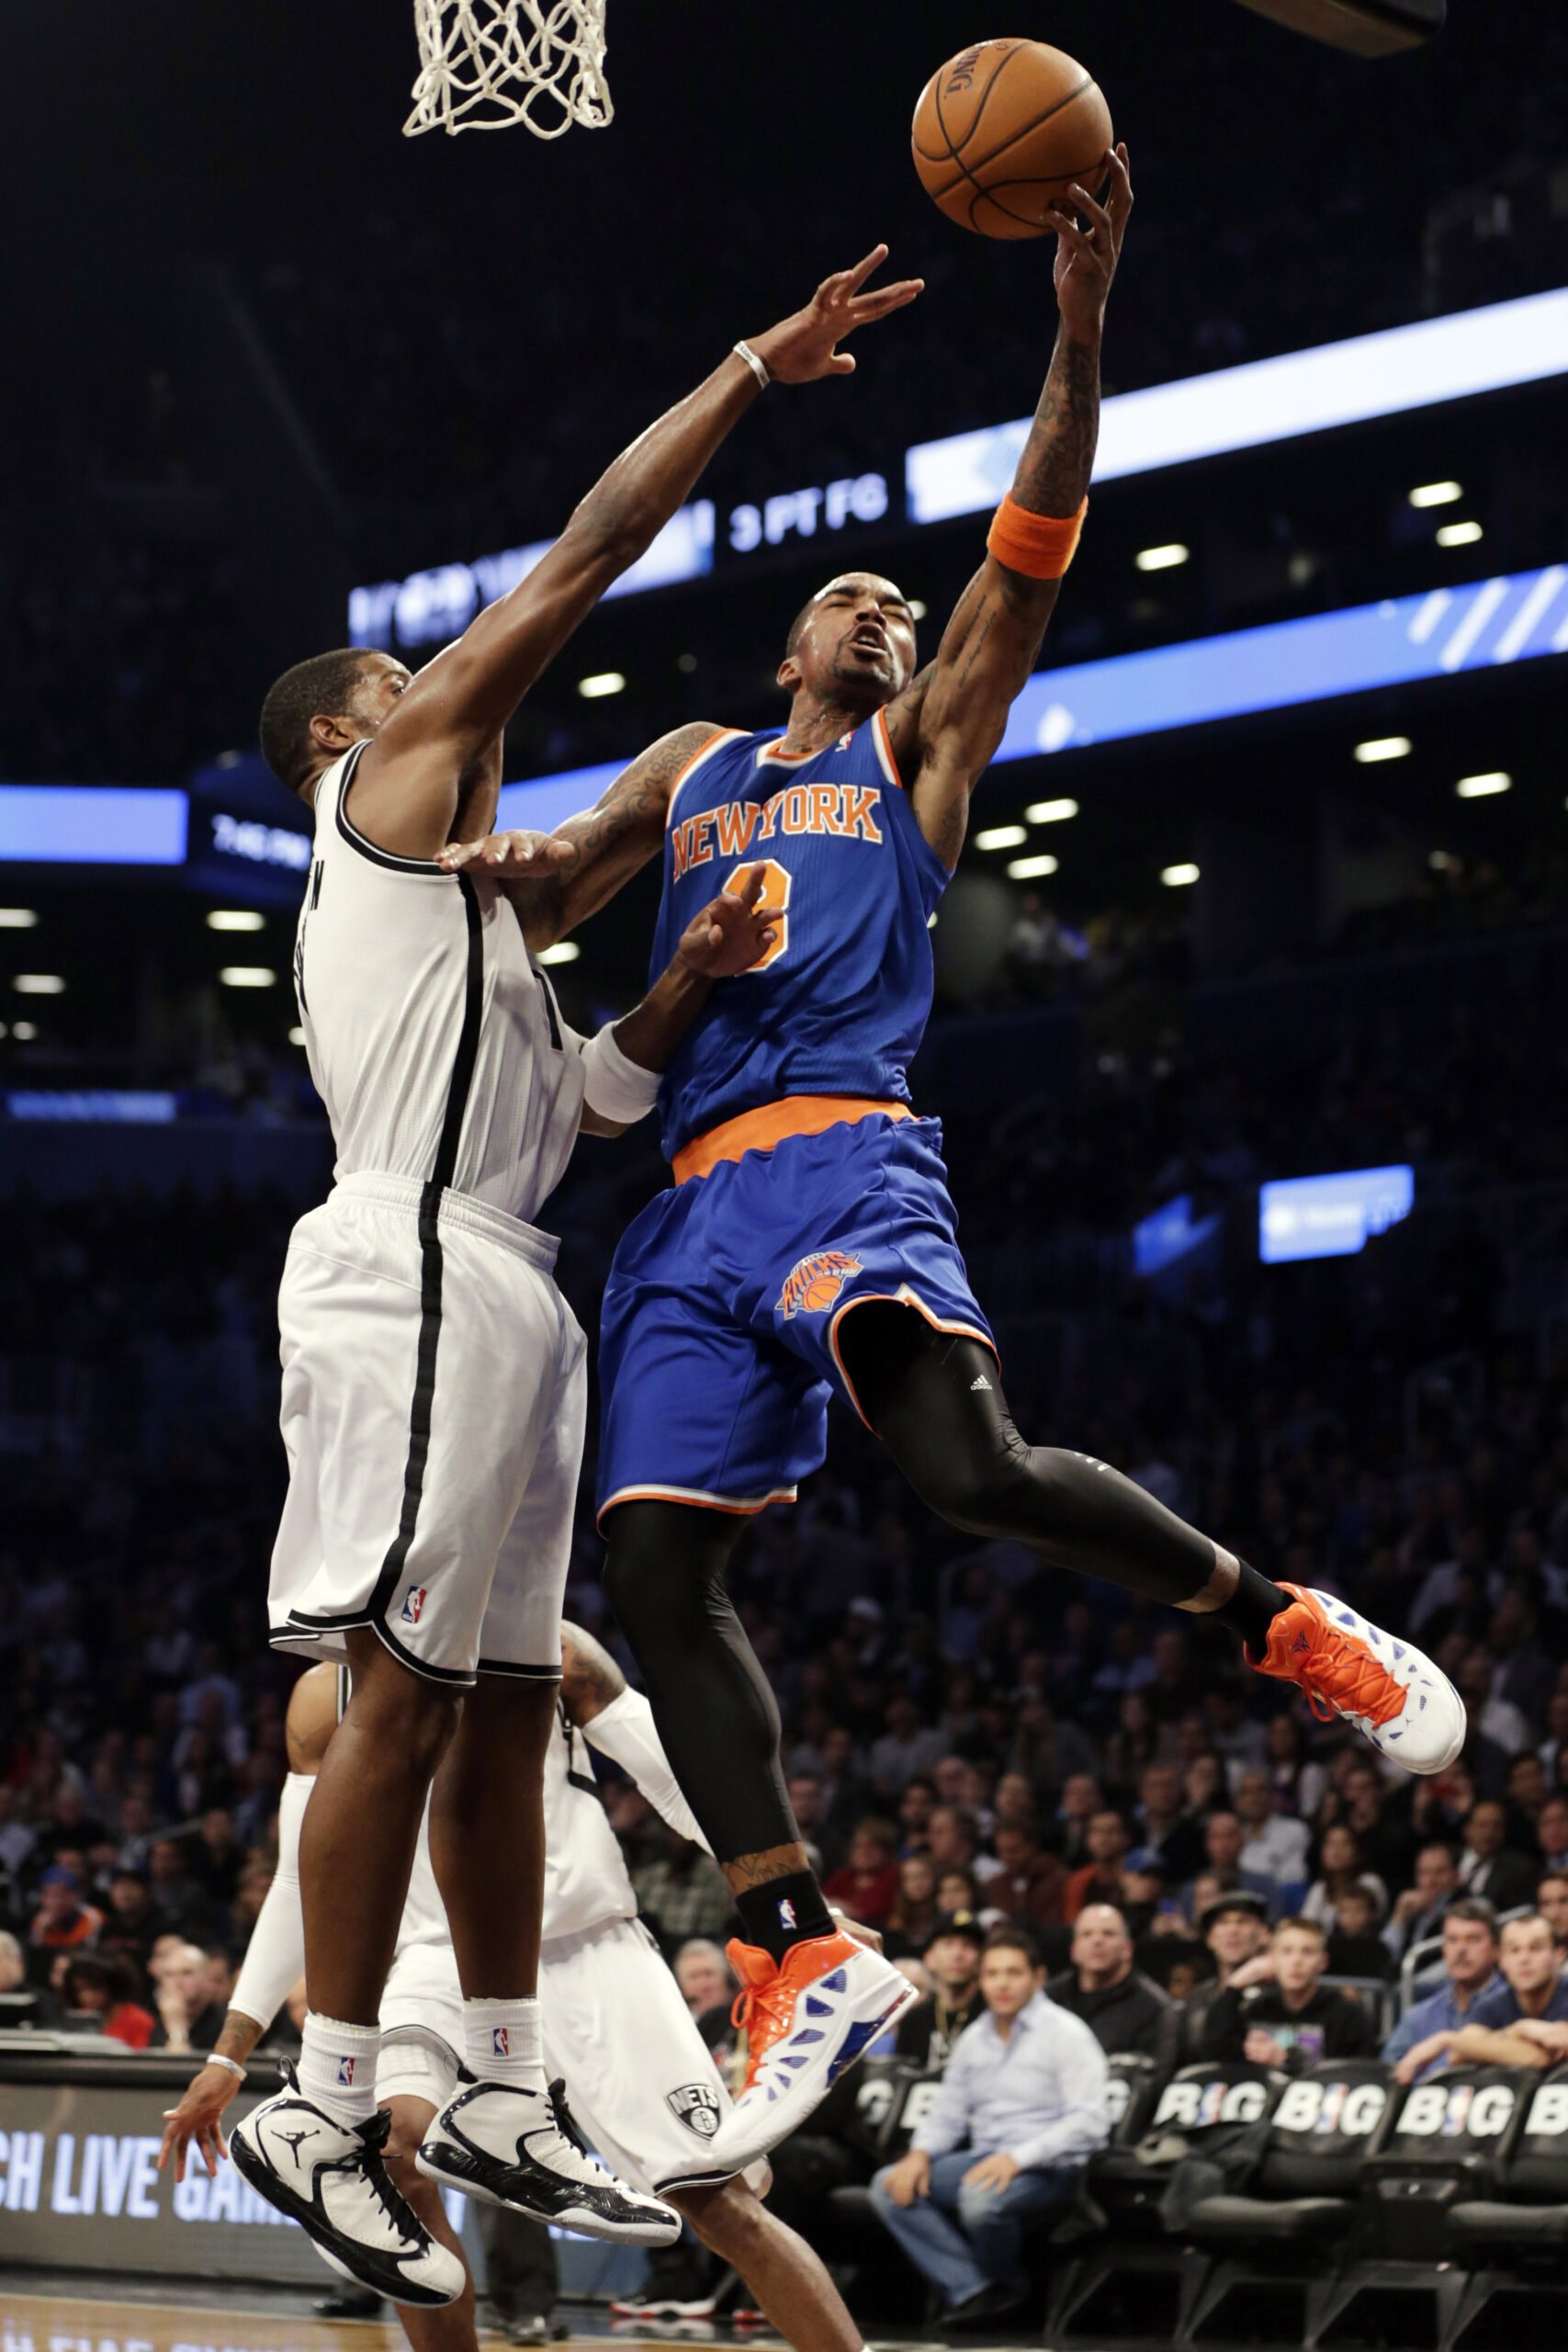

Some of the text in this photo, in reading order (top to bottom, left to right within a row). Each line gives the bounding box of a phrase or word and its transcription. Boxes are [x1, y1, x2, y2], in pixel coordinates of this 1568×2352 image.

[671, 783, 883, 885] NEW YORK
[784, 1252, 863, 1319] KNICKS
[668, 2086, 719, 2115] NETS
[1272, 2080, 1387, 2136] BIG
[1395, 2085, 1517, 2137] BIG
[51, 2132, 162, 2220] LIVE
